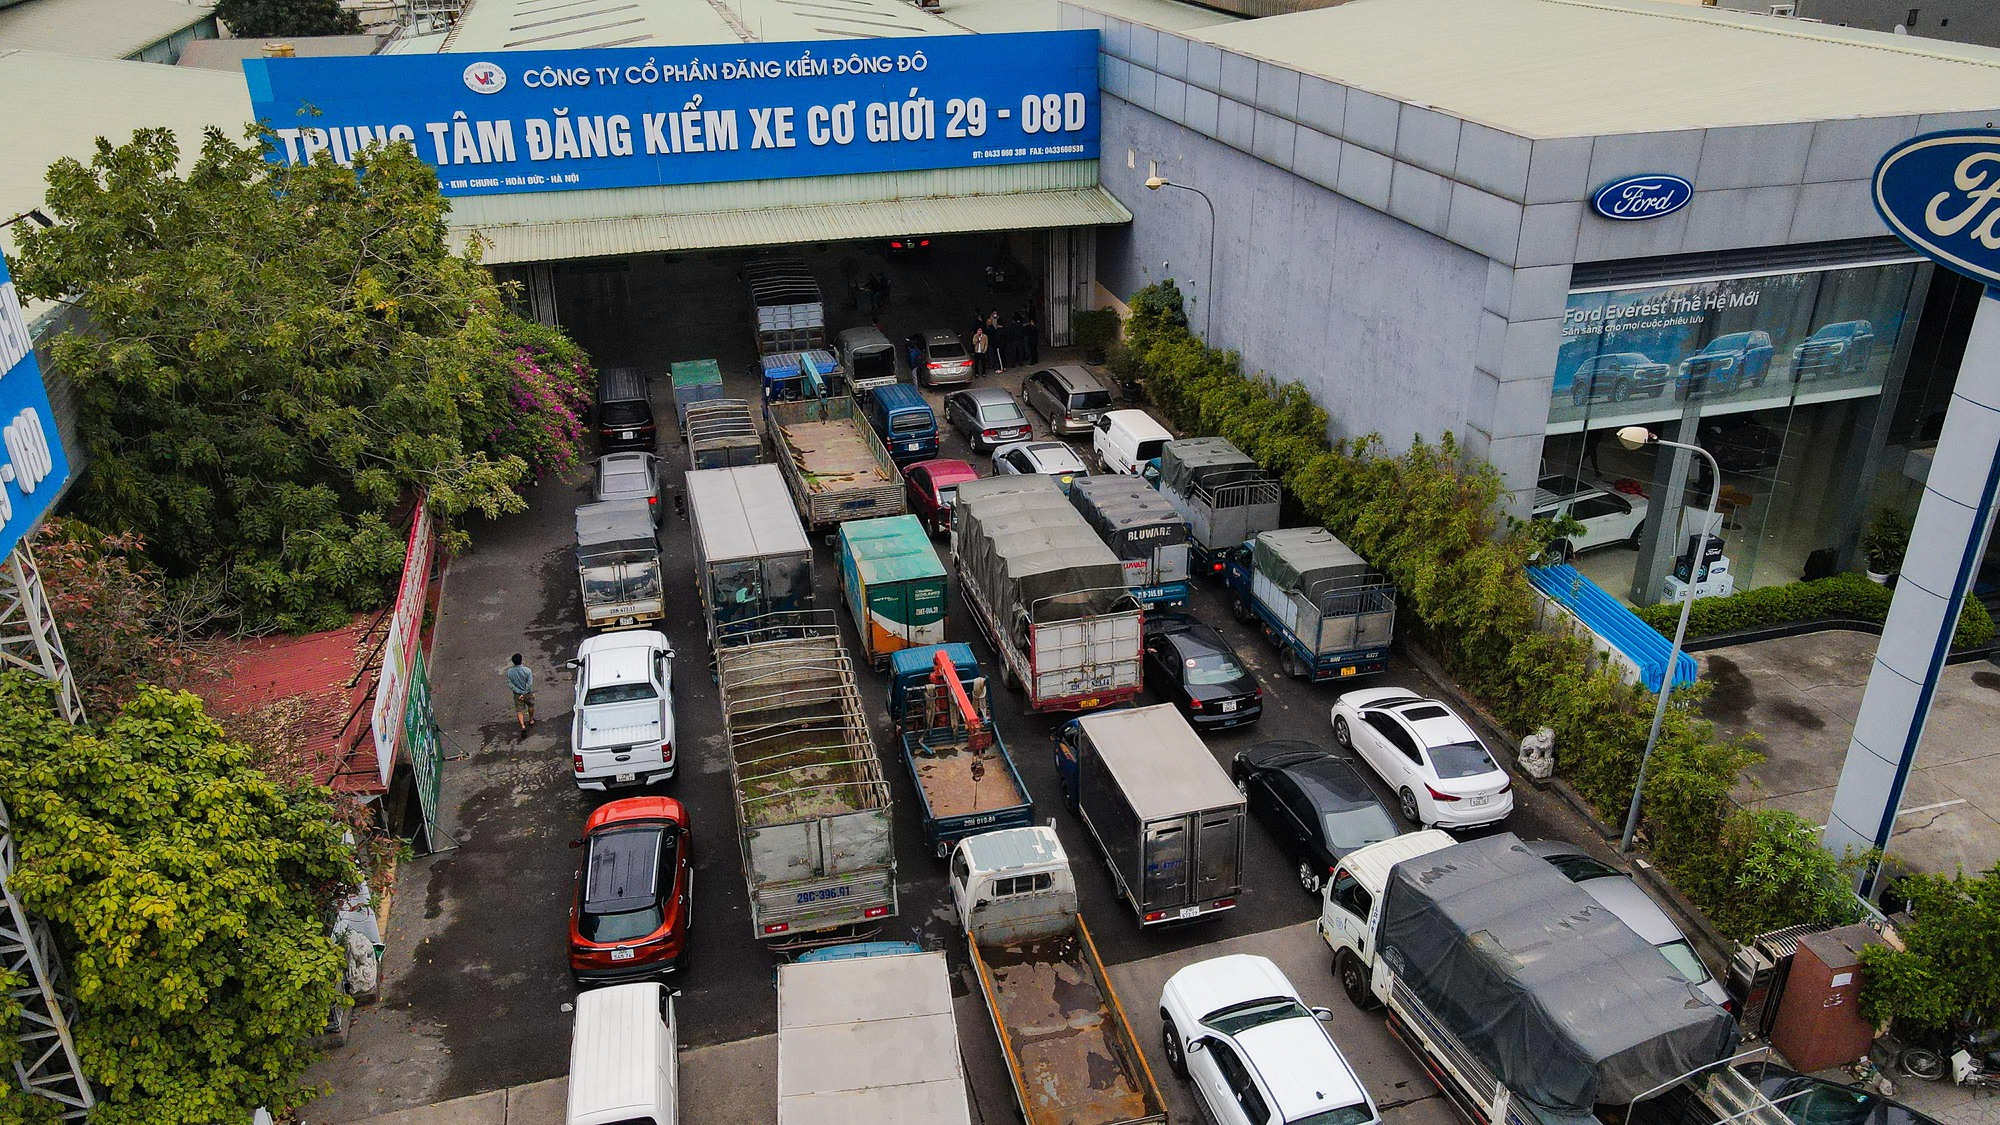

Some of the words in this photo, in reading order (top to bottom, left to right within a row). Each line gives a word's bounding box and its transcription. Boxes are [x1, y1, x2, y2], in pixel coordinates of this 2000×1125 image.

[523, 65, 590, 88] CÔNG
[595, 67, 620, 85] TY
[624, 57, 659, 84] CỔ
[663, 57, 718, 82] PHẦN
[721, 58, 782, 80] ĐĂNG
[785, 50, 828, 77] KIỂM
[832, 53, 893, 75] ĐÔNG
[897, 50, 928, 72] ĐÔ
[426, 111, 517, 165] TÂM
[525, 107, 634, 161] ĐĂNG
[642, 94, 739, 155] KIỂM
[749, 107, 796, 149] XE
[807, 100, 856, 146] CƠ
[865, 87, 935, 142] GIỚI
[945, 97, 987, 138] 29
[1021, 92, 1086, 134] 08D
[984, 149, 1001, 158] 0433
[451, 180, 468, 189] KIM
[470, 178, 499, 188] CHUNG
[505, 176, 526, 186] HOÀI
[527, 174, 545, 184] ĐỨC
[550, 173, 563, 184] HÀ
[565, 172, 580, 184] NỘI
[1613, 184, 1675, 215] Ford
[1563, 306, 1603, 324] Ford
[1605, 301, 1667, 320] Everest
[1704, 294, 1726, 312] Hệ
[1729, 291, 1760, 309] Mới
[1604, 323, 1622, 333] cho
[1127, 526, 1172, 541] BLUWARE
[1705, 548, 1722, 556] Ford
[797, 887, 850, 904] 29C-396.91
